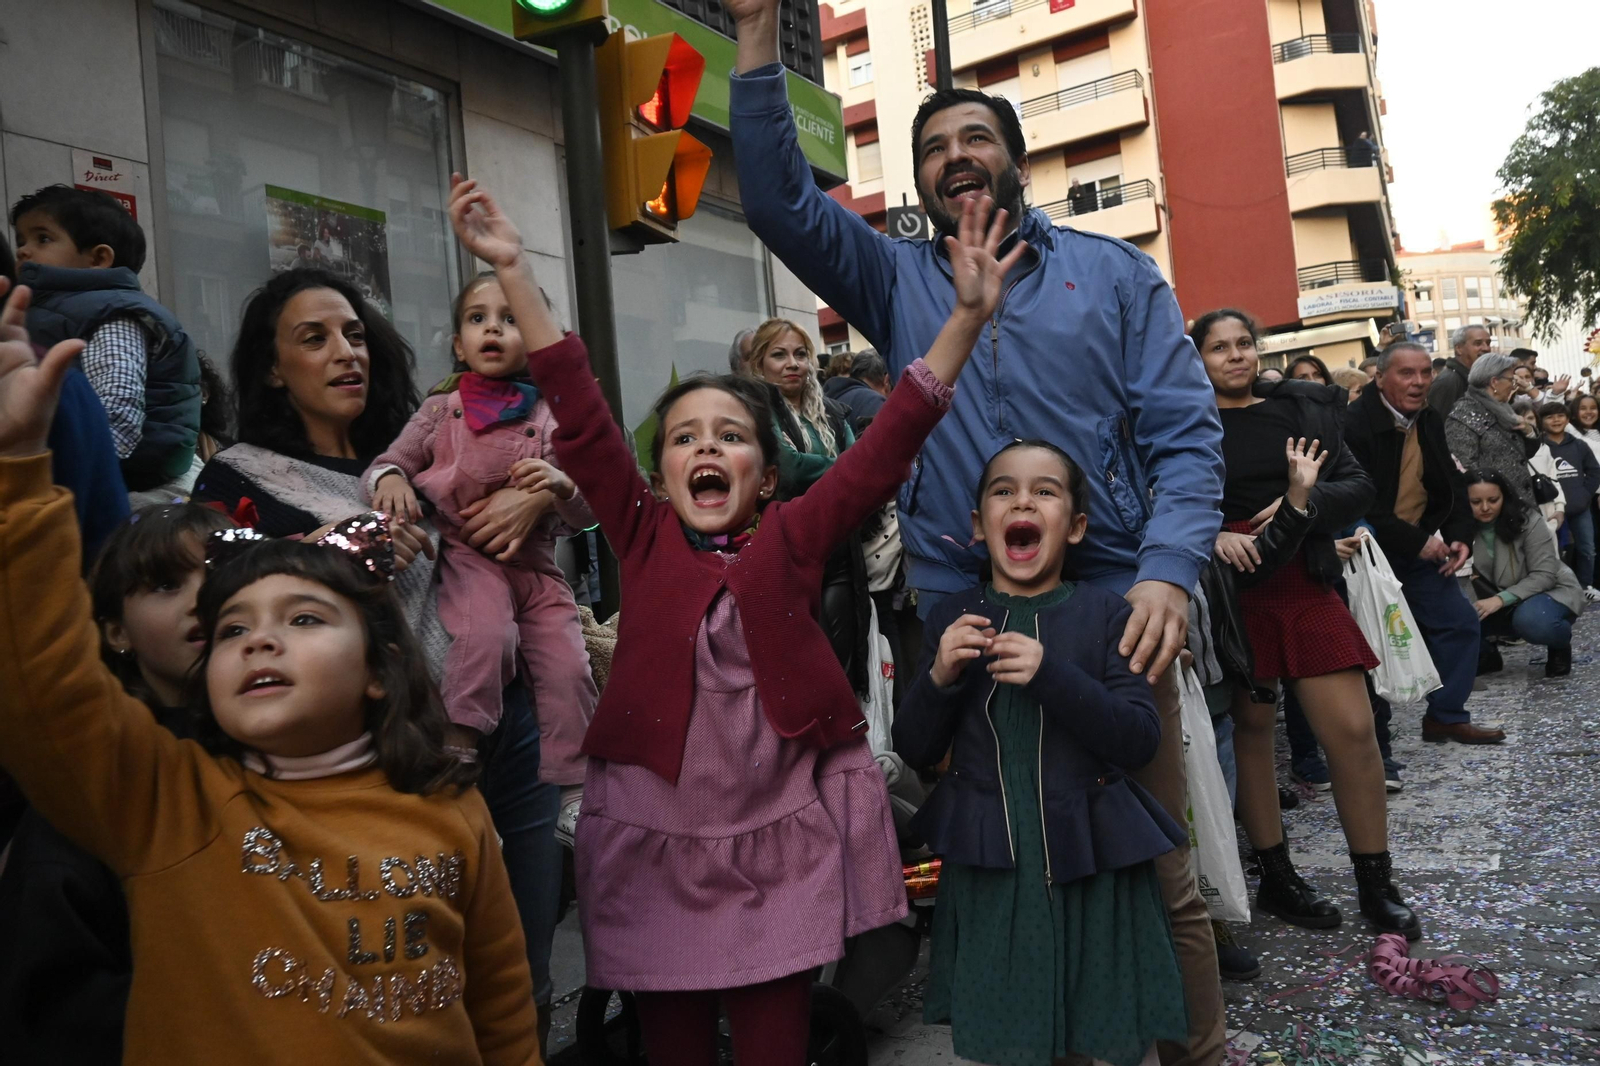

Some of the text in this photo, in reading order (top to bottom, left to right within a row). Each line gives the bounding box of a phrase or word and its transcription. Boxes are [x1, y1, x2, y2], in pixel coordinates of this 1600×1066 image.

[796, 114, 835, 145] CLIENTE
[84, 169, 123, 182] Direct
[1303, 301, 1333, 310] LABORAL
[347, 910, 429, 965] LIE
